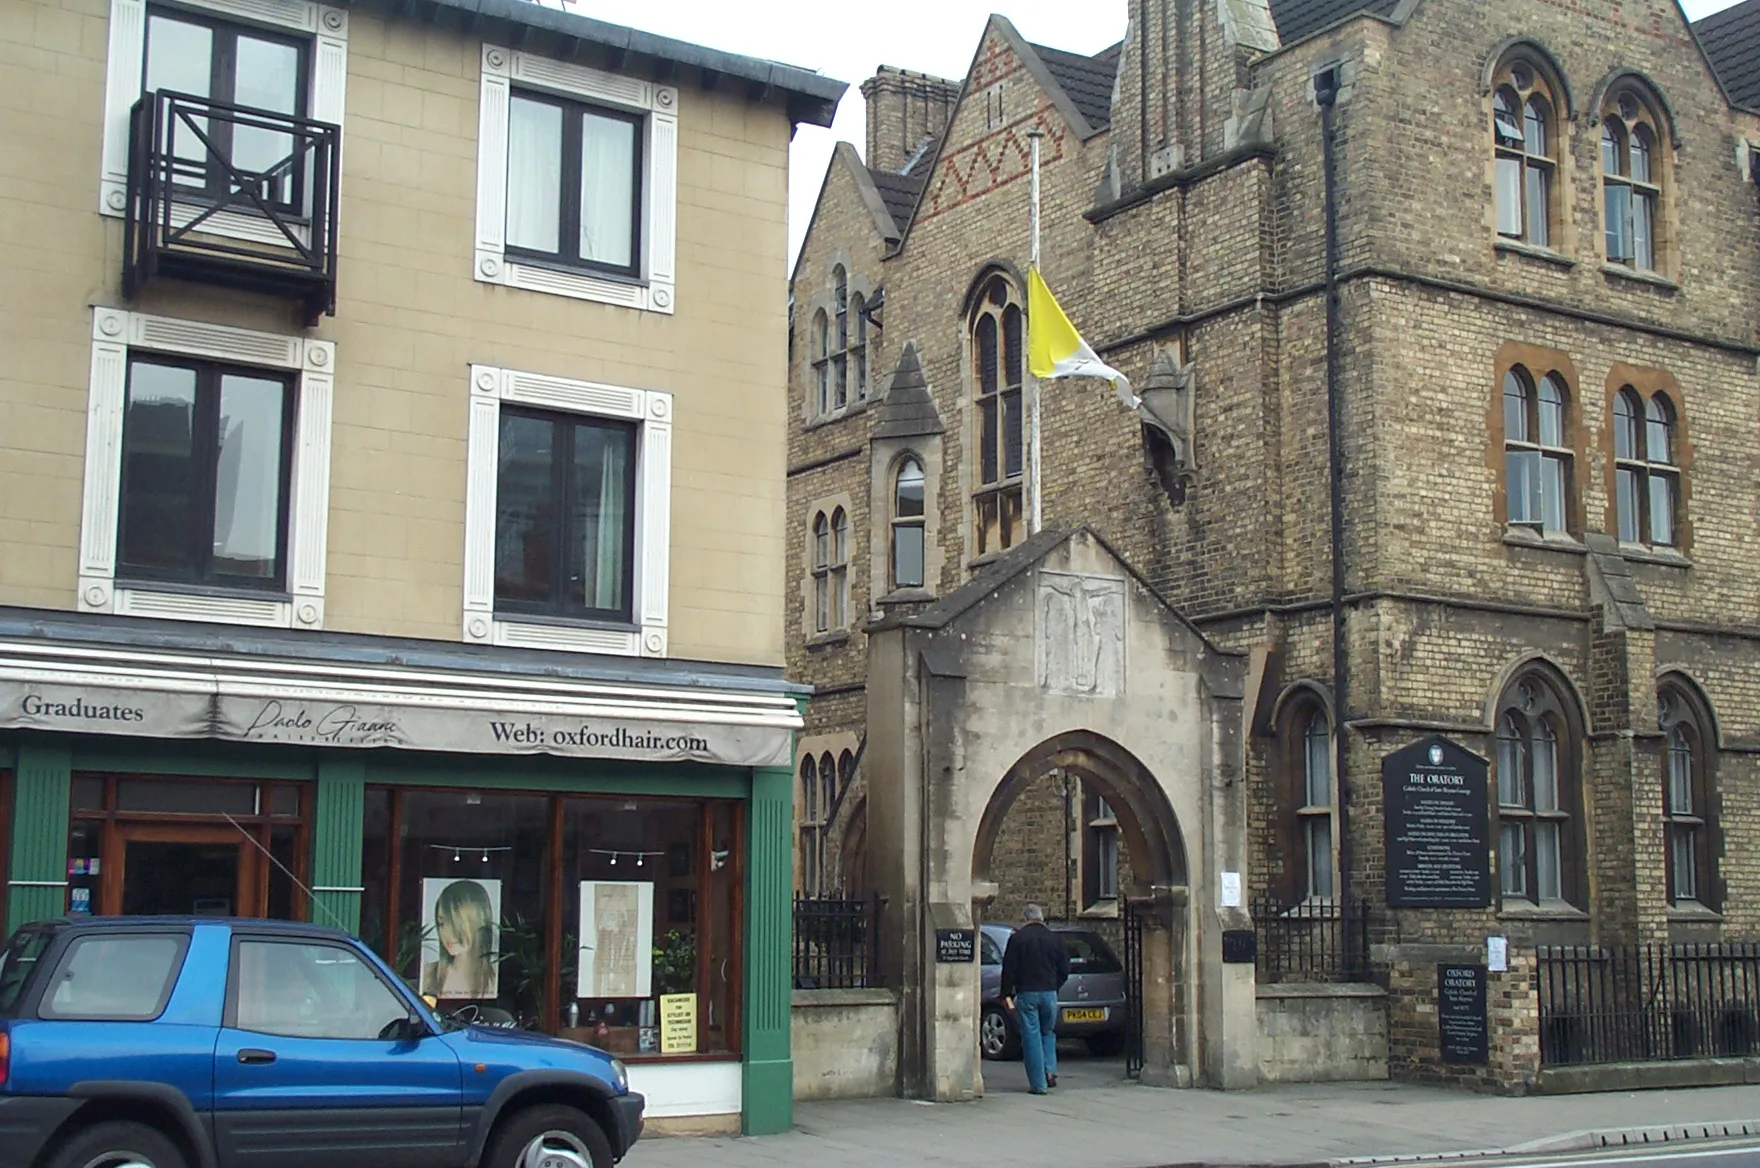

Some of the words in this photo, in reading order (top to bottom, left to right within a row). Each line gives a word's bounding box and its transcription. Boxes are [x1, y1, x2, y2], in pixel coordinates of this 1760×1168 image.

[22, 694, 144, 722] Graduates
[244, 700, 312, 738] Paolo
[489, 721, 546, 744] Web:
[552, 725, 708, 751] oxfordhair.com
[1409, 773, 1425, 784] THE
[1427, 774, 1465, 786] ORATORY
[950, 932, 962, 940] NO
[940, 940, 972, 949] PARKING
[1446, 969, 1475, 978] OXFORD
[1444, 979, 1476, 988] ORATORY
